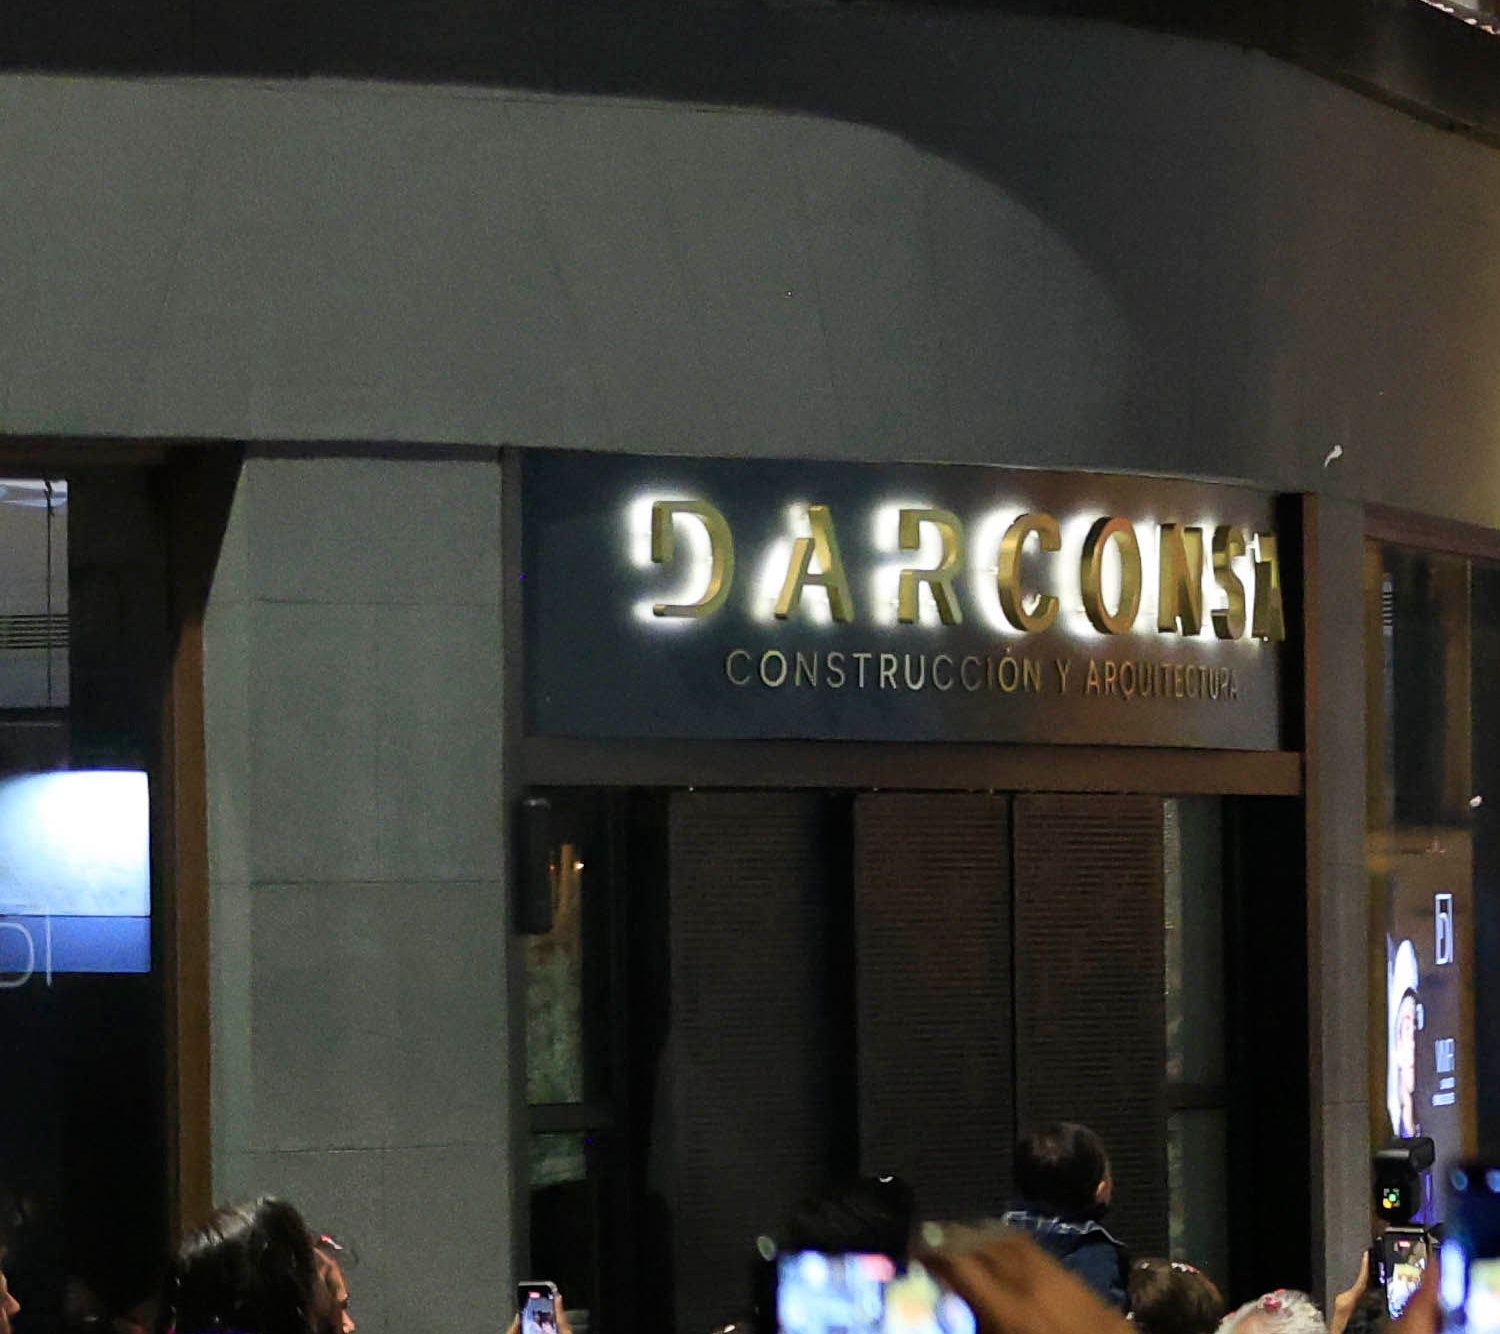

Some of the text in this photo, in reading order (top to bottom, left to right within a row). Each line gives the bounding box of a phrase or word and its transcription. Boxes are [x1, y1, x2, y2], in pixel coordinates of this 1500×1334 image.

[724, 646, 1239, 701] CONSTRUCCIÓN Y ARQUITECTURA
